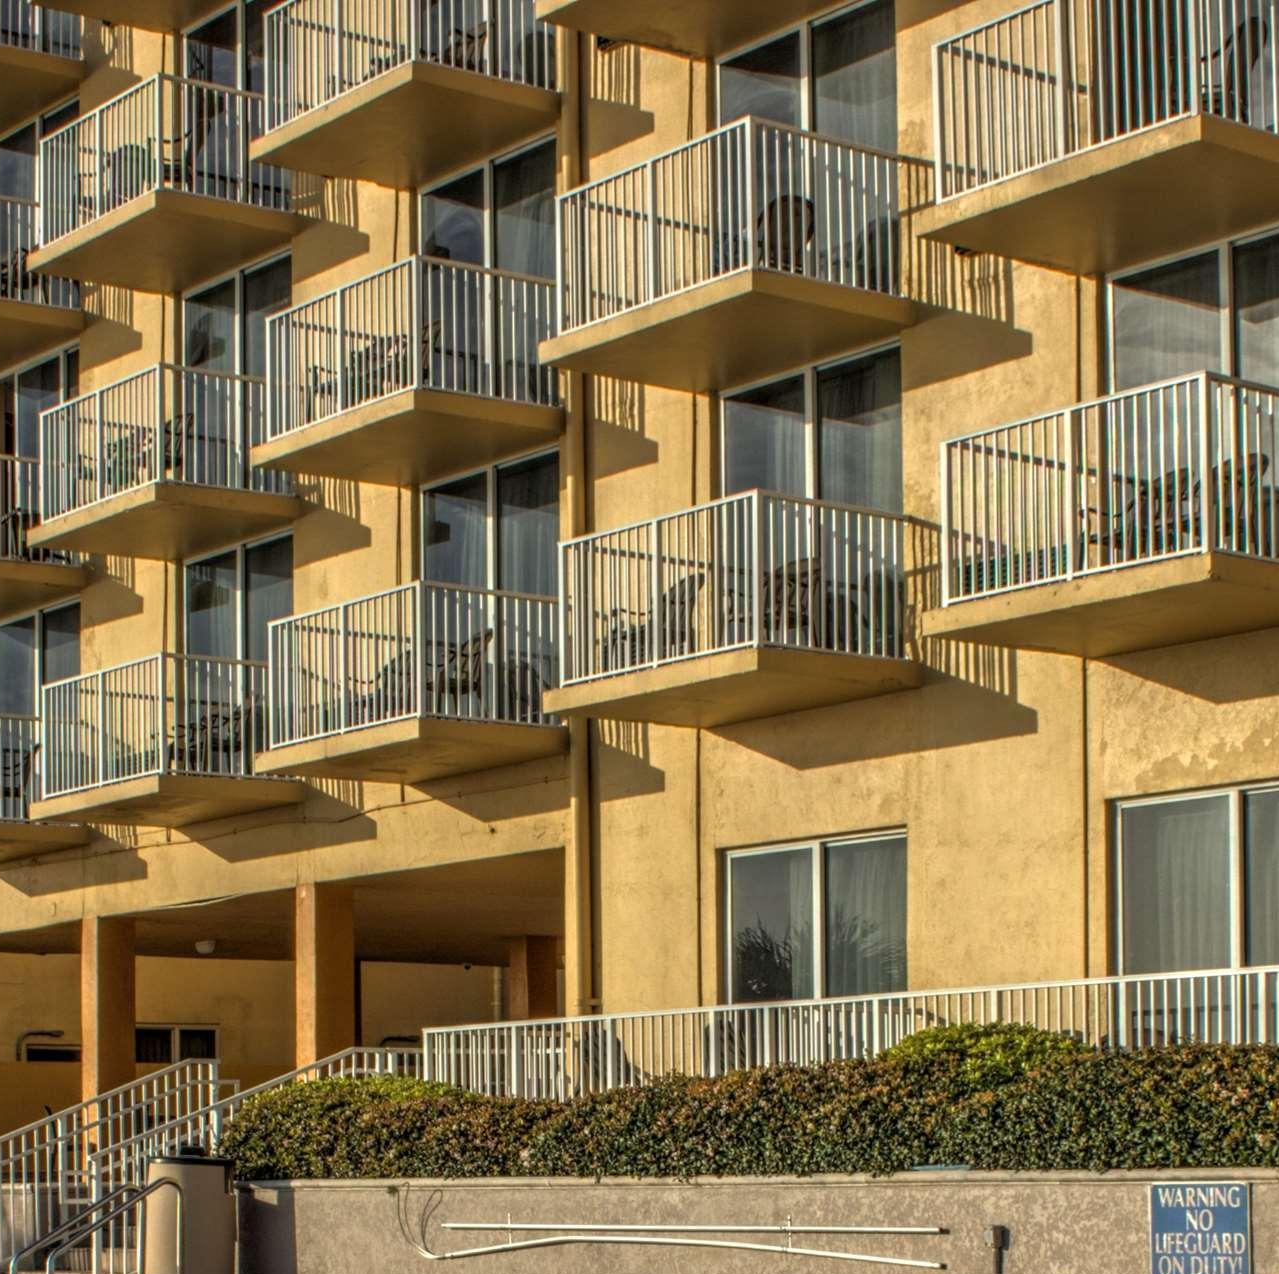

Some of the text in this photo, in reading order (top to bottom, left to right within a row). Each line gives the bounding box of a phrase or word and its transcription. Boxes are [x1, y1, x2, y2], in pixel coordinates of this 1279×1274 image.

[1158, 1186, 1241, 1207] WARNING
[1186, 1209, 1214, 1231] NO
[1155, 1232, 1246, 1254] LIFEGUARD
